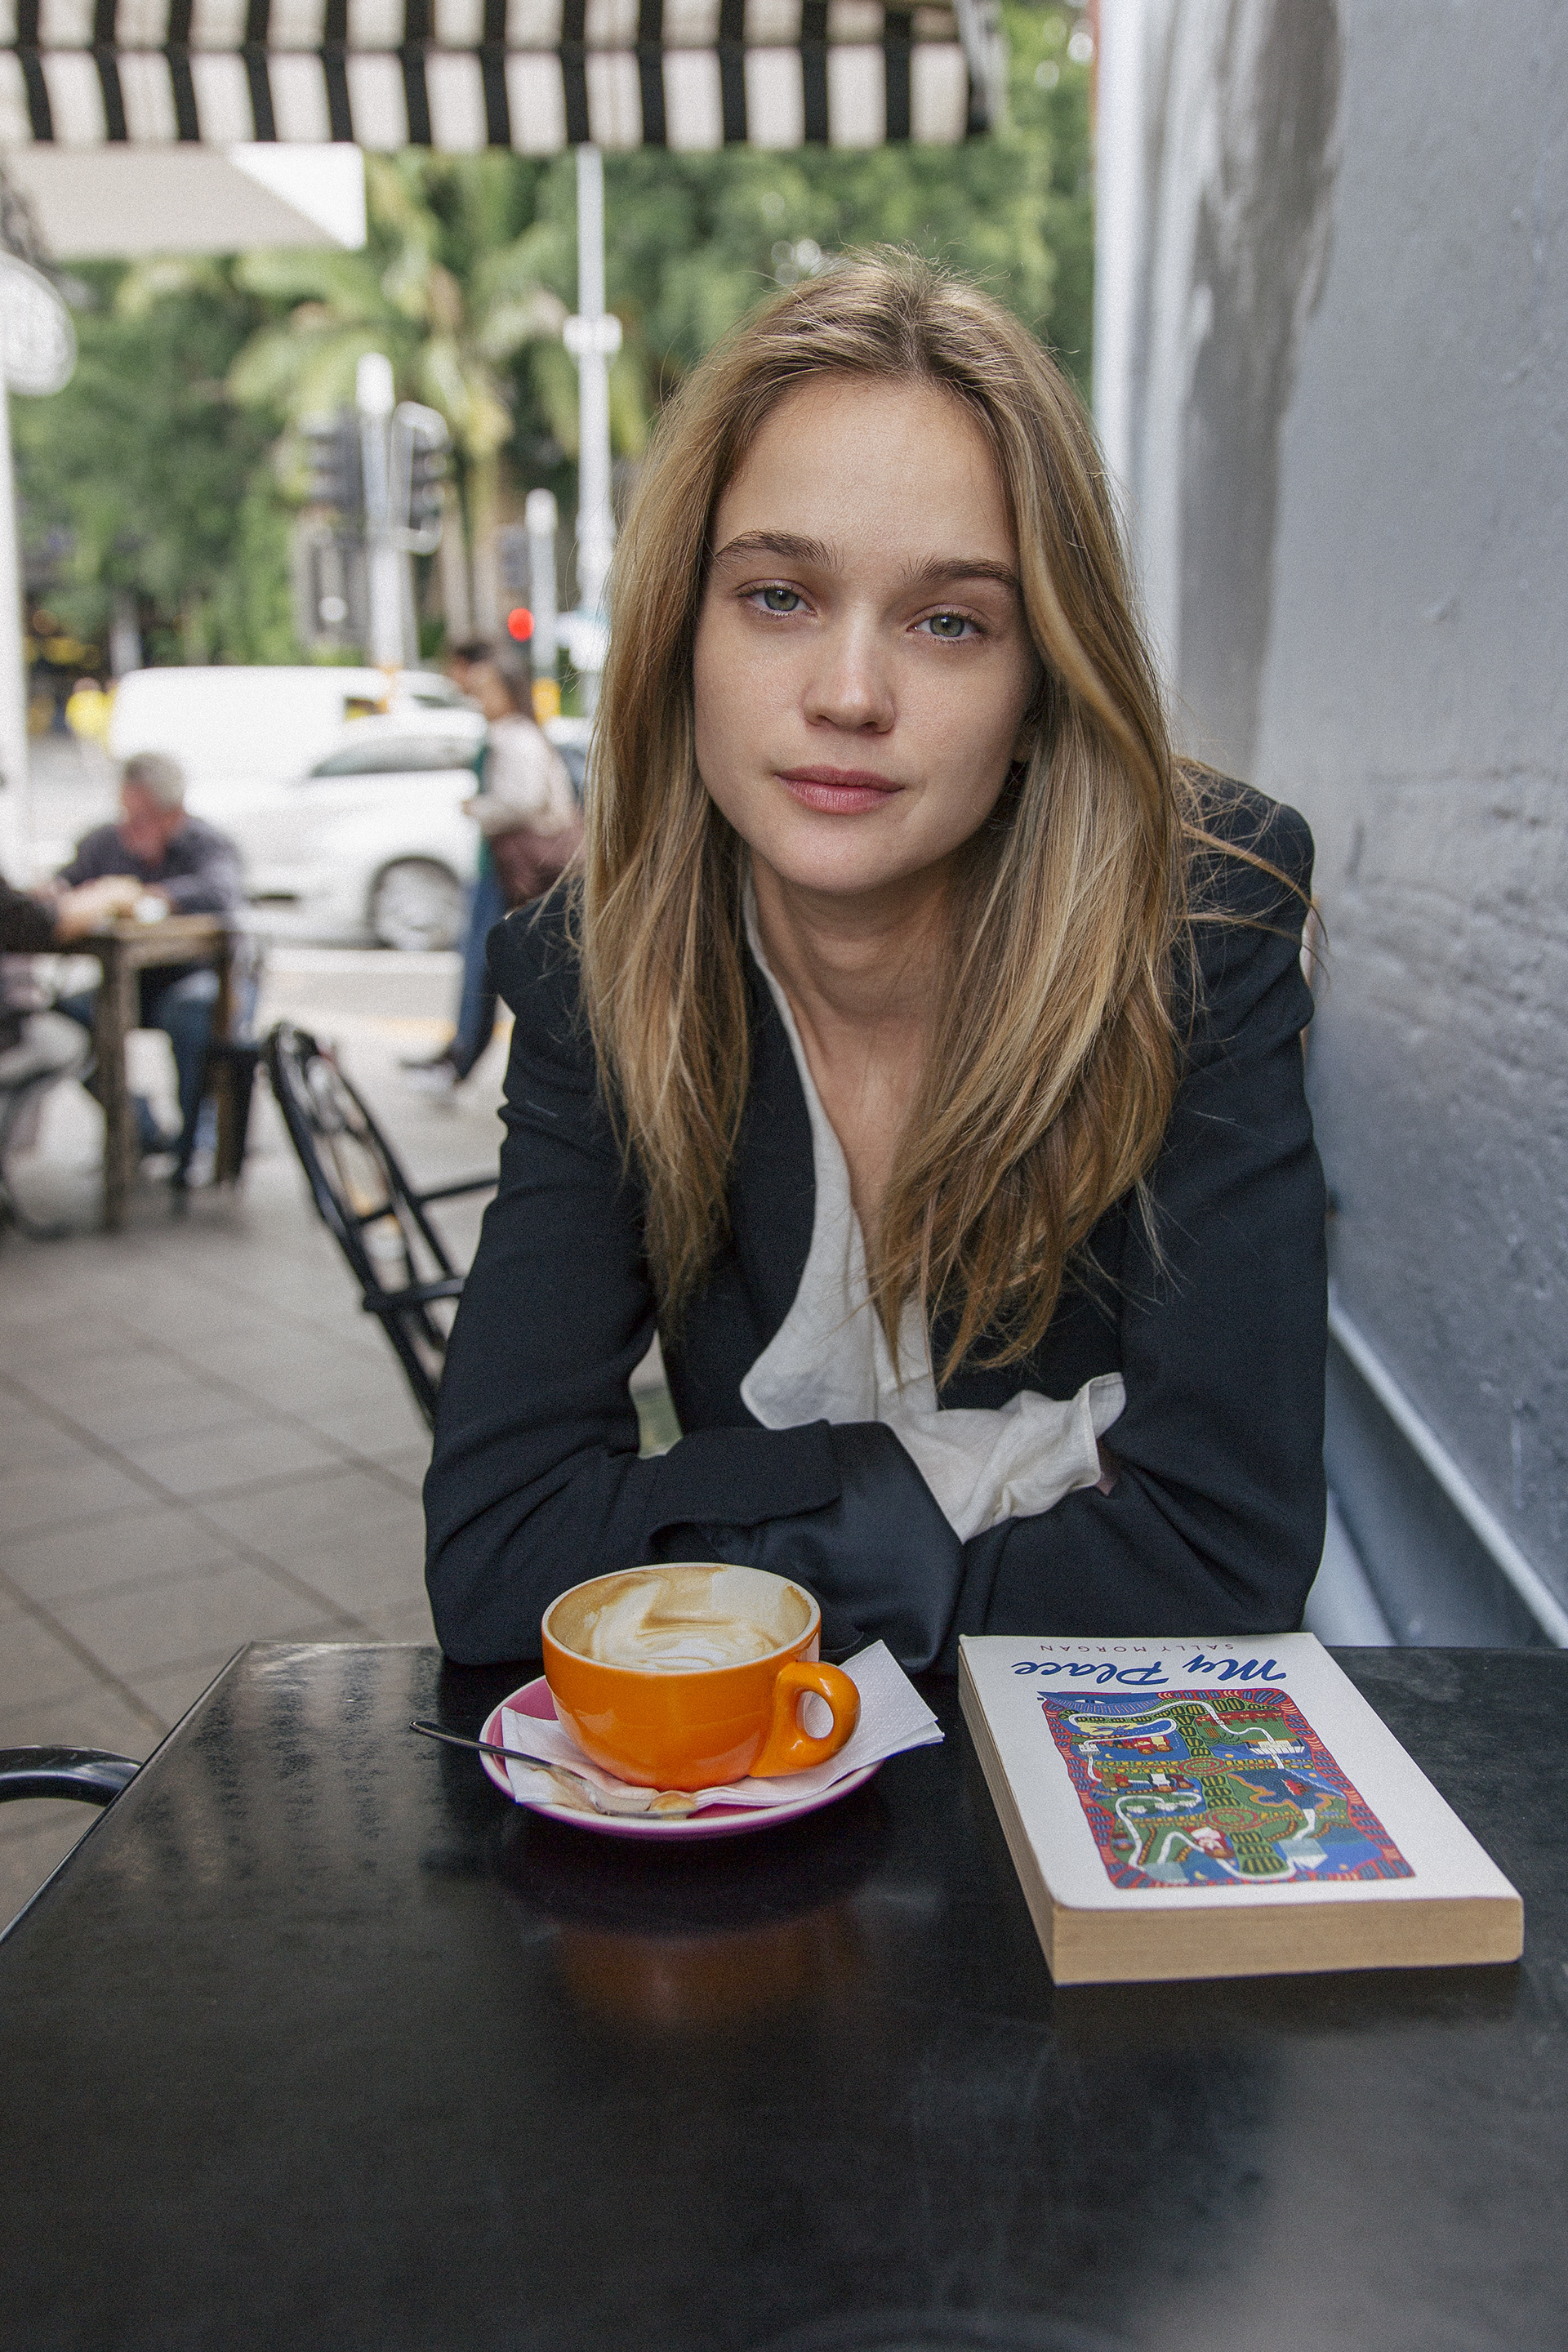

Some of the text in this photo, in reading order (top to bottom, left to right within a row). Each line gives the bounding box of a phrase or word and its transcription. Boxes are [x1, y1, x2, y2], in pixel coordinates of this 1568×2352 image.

[1040, 1643, 1235, 1652] SALLY MORGAN
[1011, 1655, 1286, 1685] My Place
